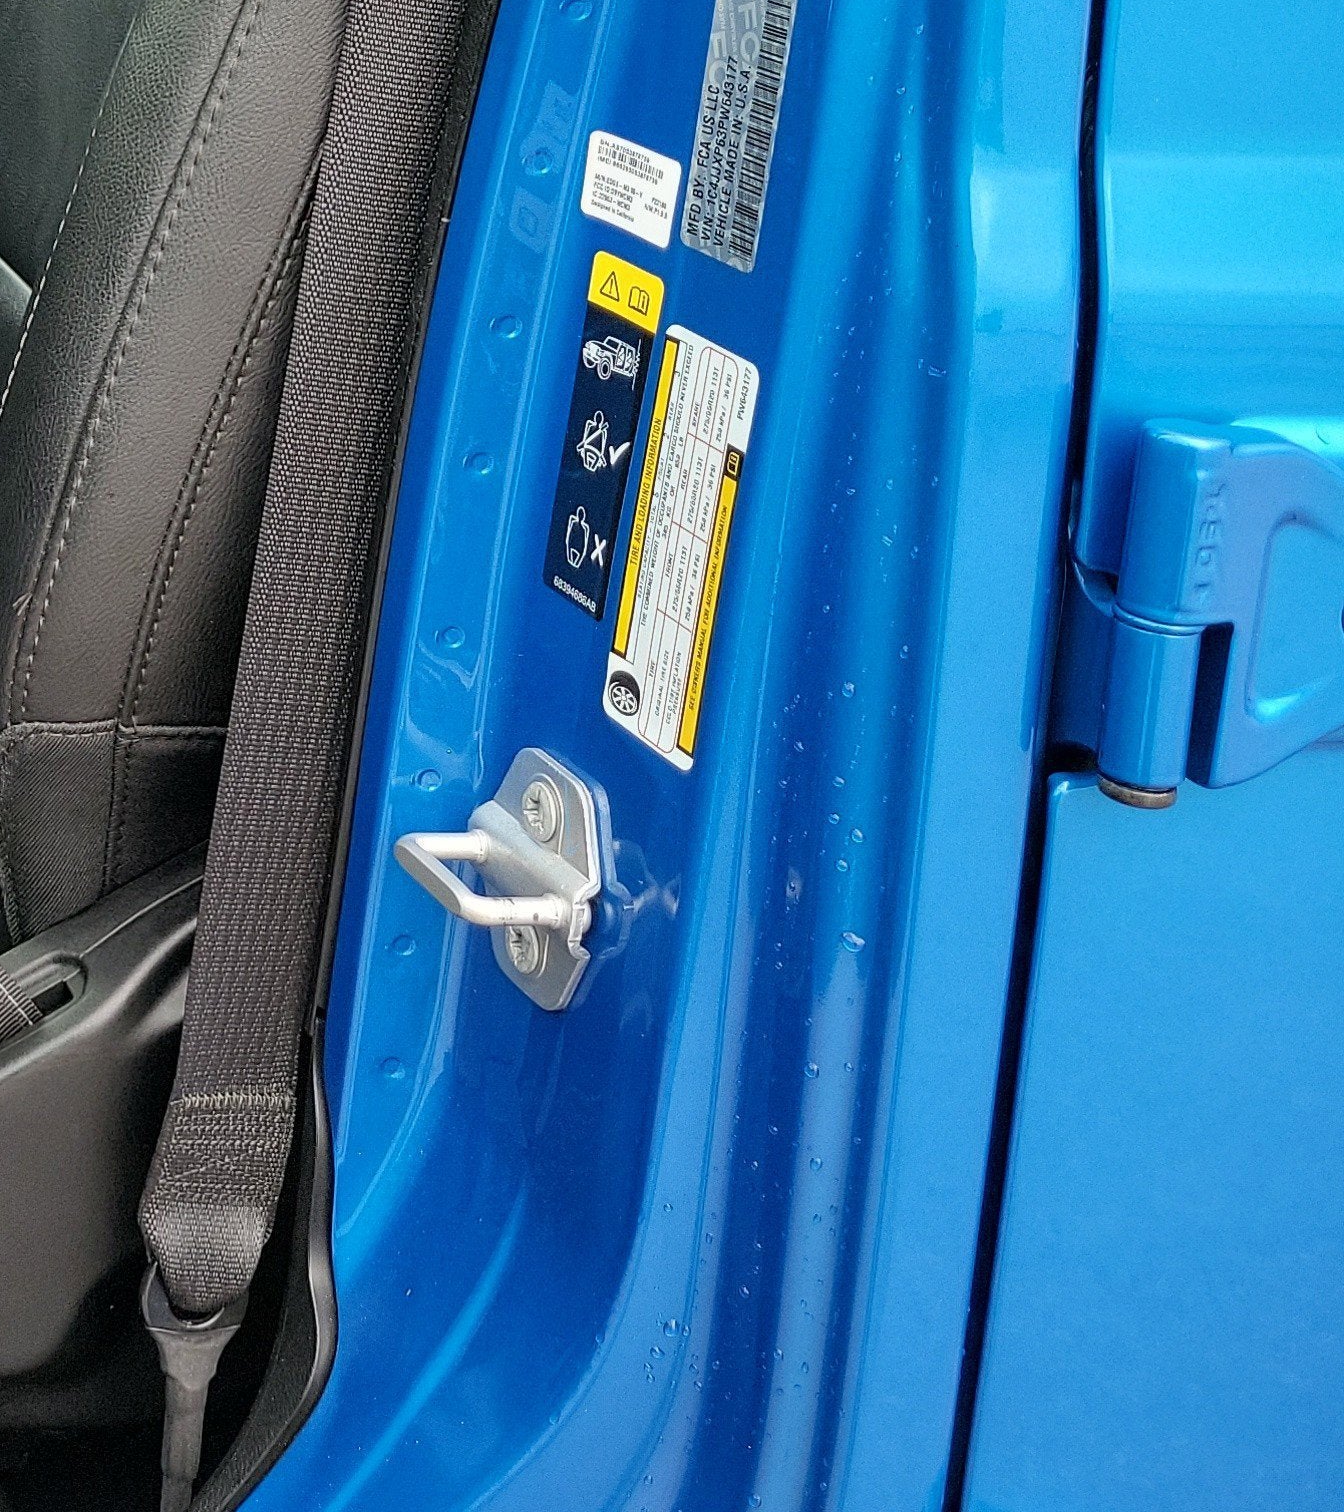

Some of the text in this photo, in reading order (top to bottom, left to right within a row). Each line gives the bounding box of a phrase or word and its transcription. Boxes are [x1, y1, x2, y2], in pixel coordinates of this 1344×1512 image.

[687, 83, 720, 238] MFD BY: FCA US LLC
[701, 55, 739, 244] VIN: 1C4JJXP63PW643177
[714, 62, 752, 249] VEHICLE MADE IN: U.S.A.
[645, 417, 661, 481] INFORMATION
[638, 481, 651, 523] LOADING
[630, 544, 640, 567] TIRE
[634, 523, 643, 544] AND
[553, 575, 597, 613] 68394686AB
